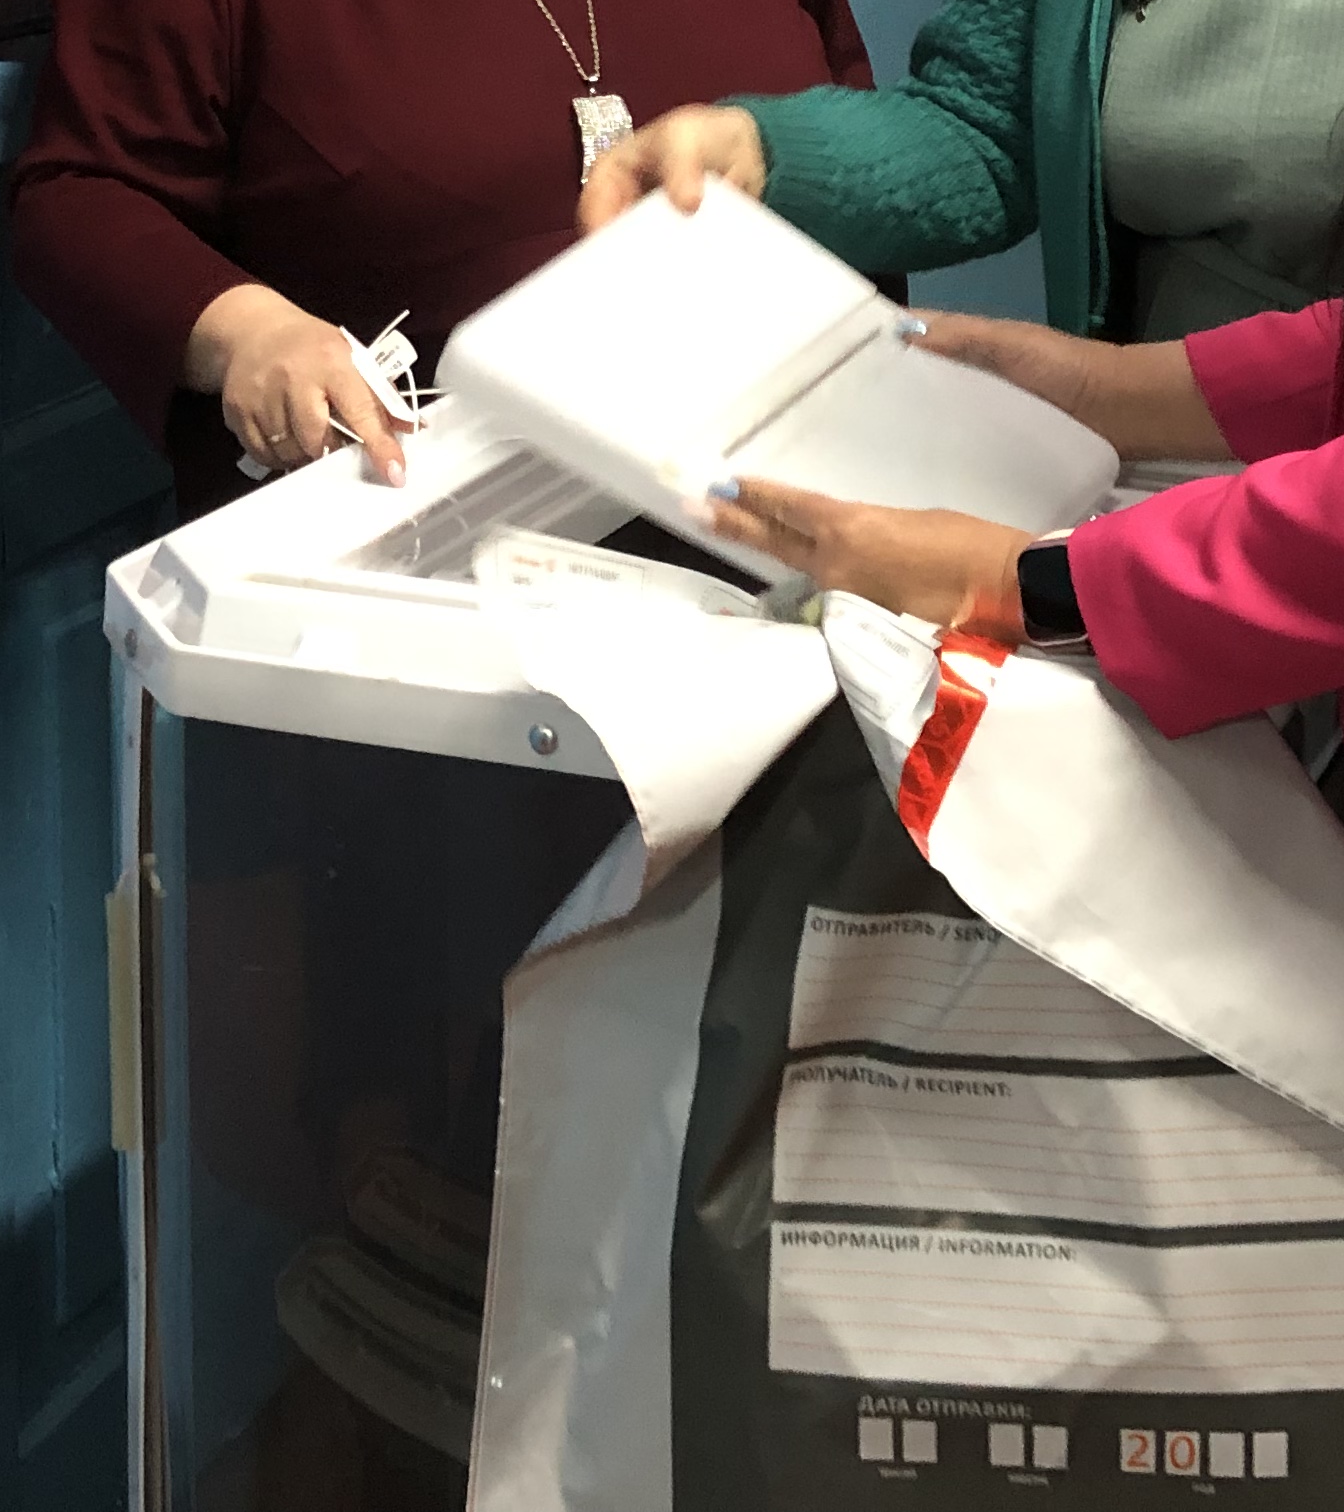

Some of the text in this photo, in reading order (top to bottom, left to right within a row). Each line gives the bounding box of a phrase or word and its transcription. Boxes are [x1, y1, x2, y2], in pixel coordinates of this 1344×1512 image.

[810, 915, 936, 937] ОТПРАВИТЕЛЬ
[781, 1230, 920, 1254] ИНФОРМАЦИЯ
[858, 1394, 911, 1416] ДАТА
